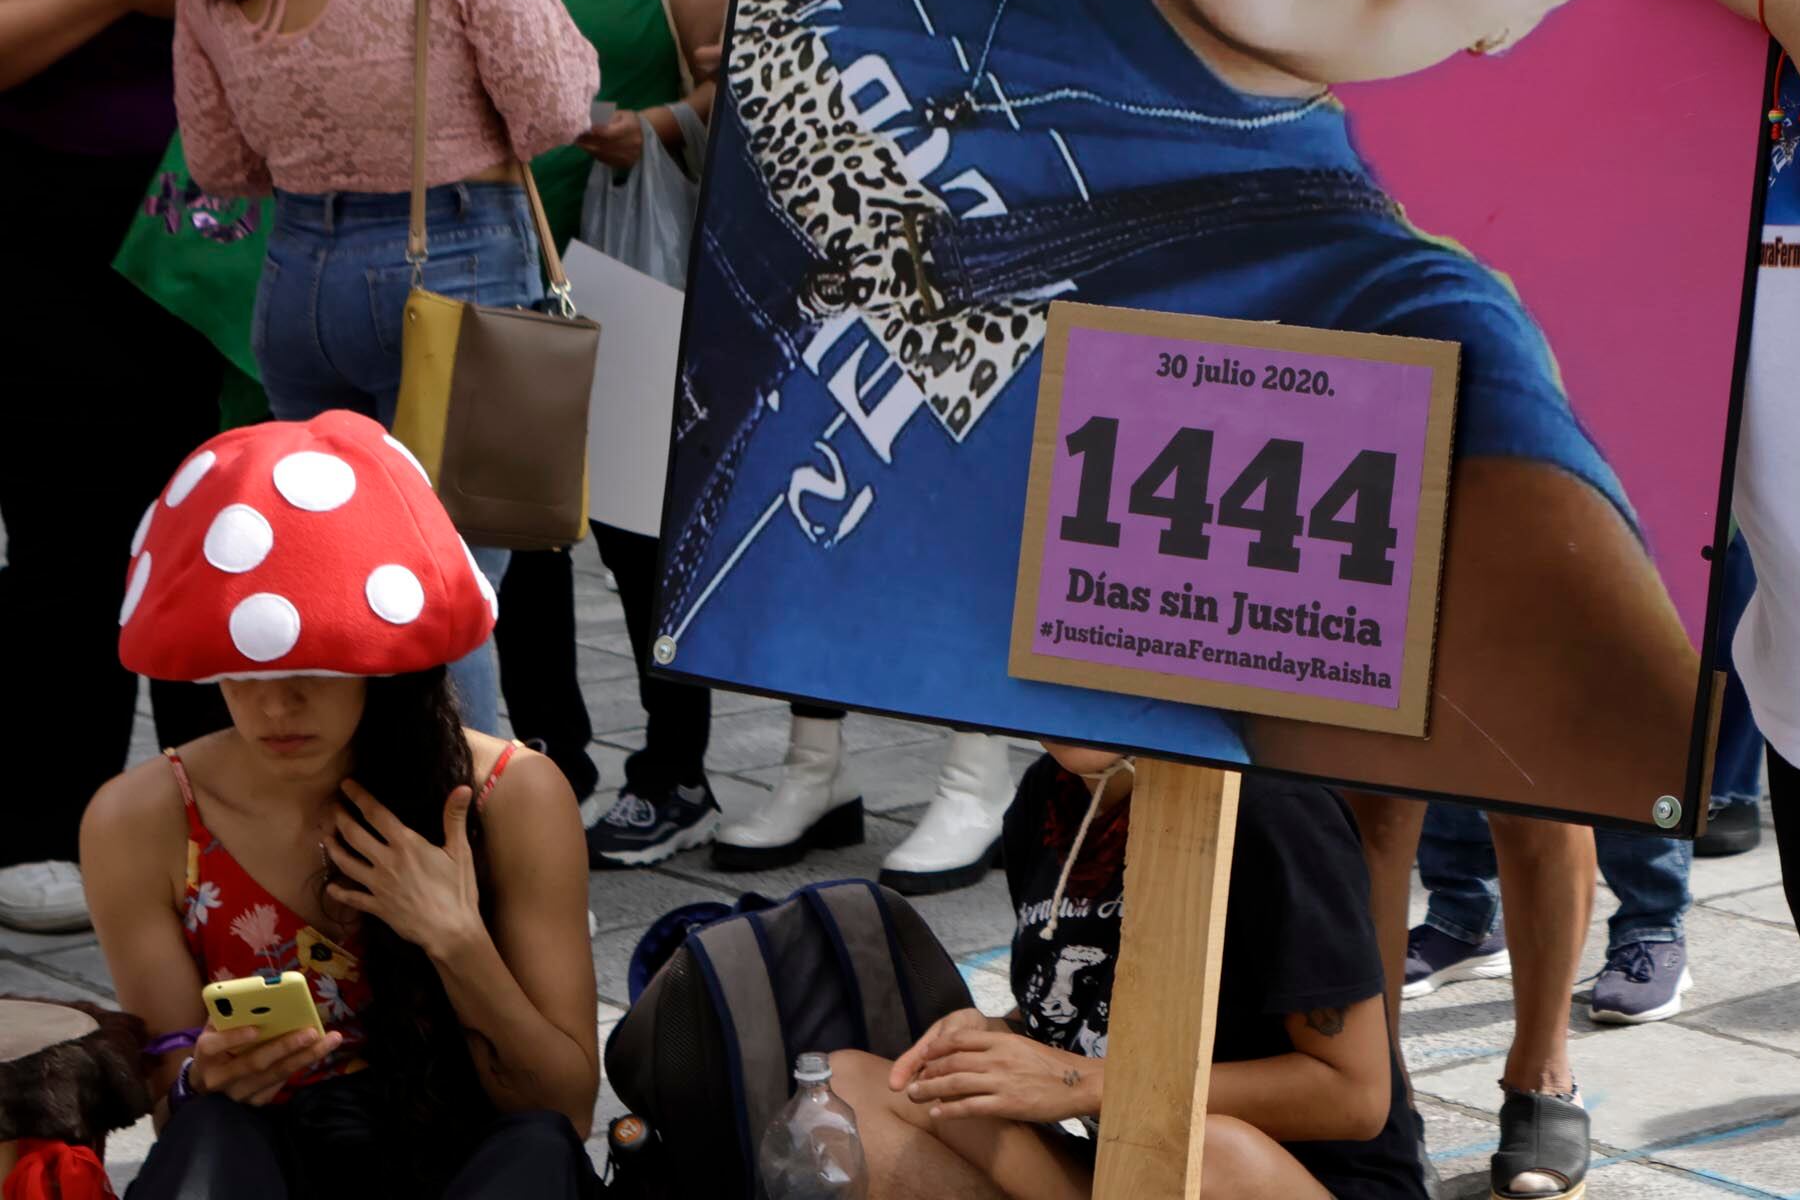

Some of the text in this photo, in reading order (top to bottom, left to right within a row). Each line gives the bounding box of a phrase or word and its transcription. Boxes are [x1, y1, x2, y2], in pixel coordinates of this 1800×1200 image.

[1156, 352, 1336, 398] 30 julio 2020.
[1058, 415, 1399, 586] 1444
[1066, 567, 1383, 648] Días sin Justicia
[1040, 619, 1393, 690] #JusticiaparaFernandayRaisha
